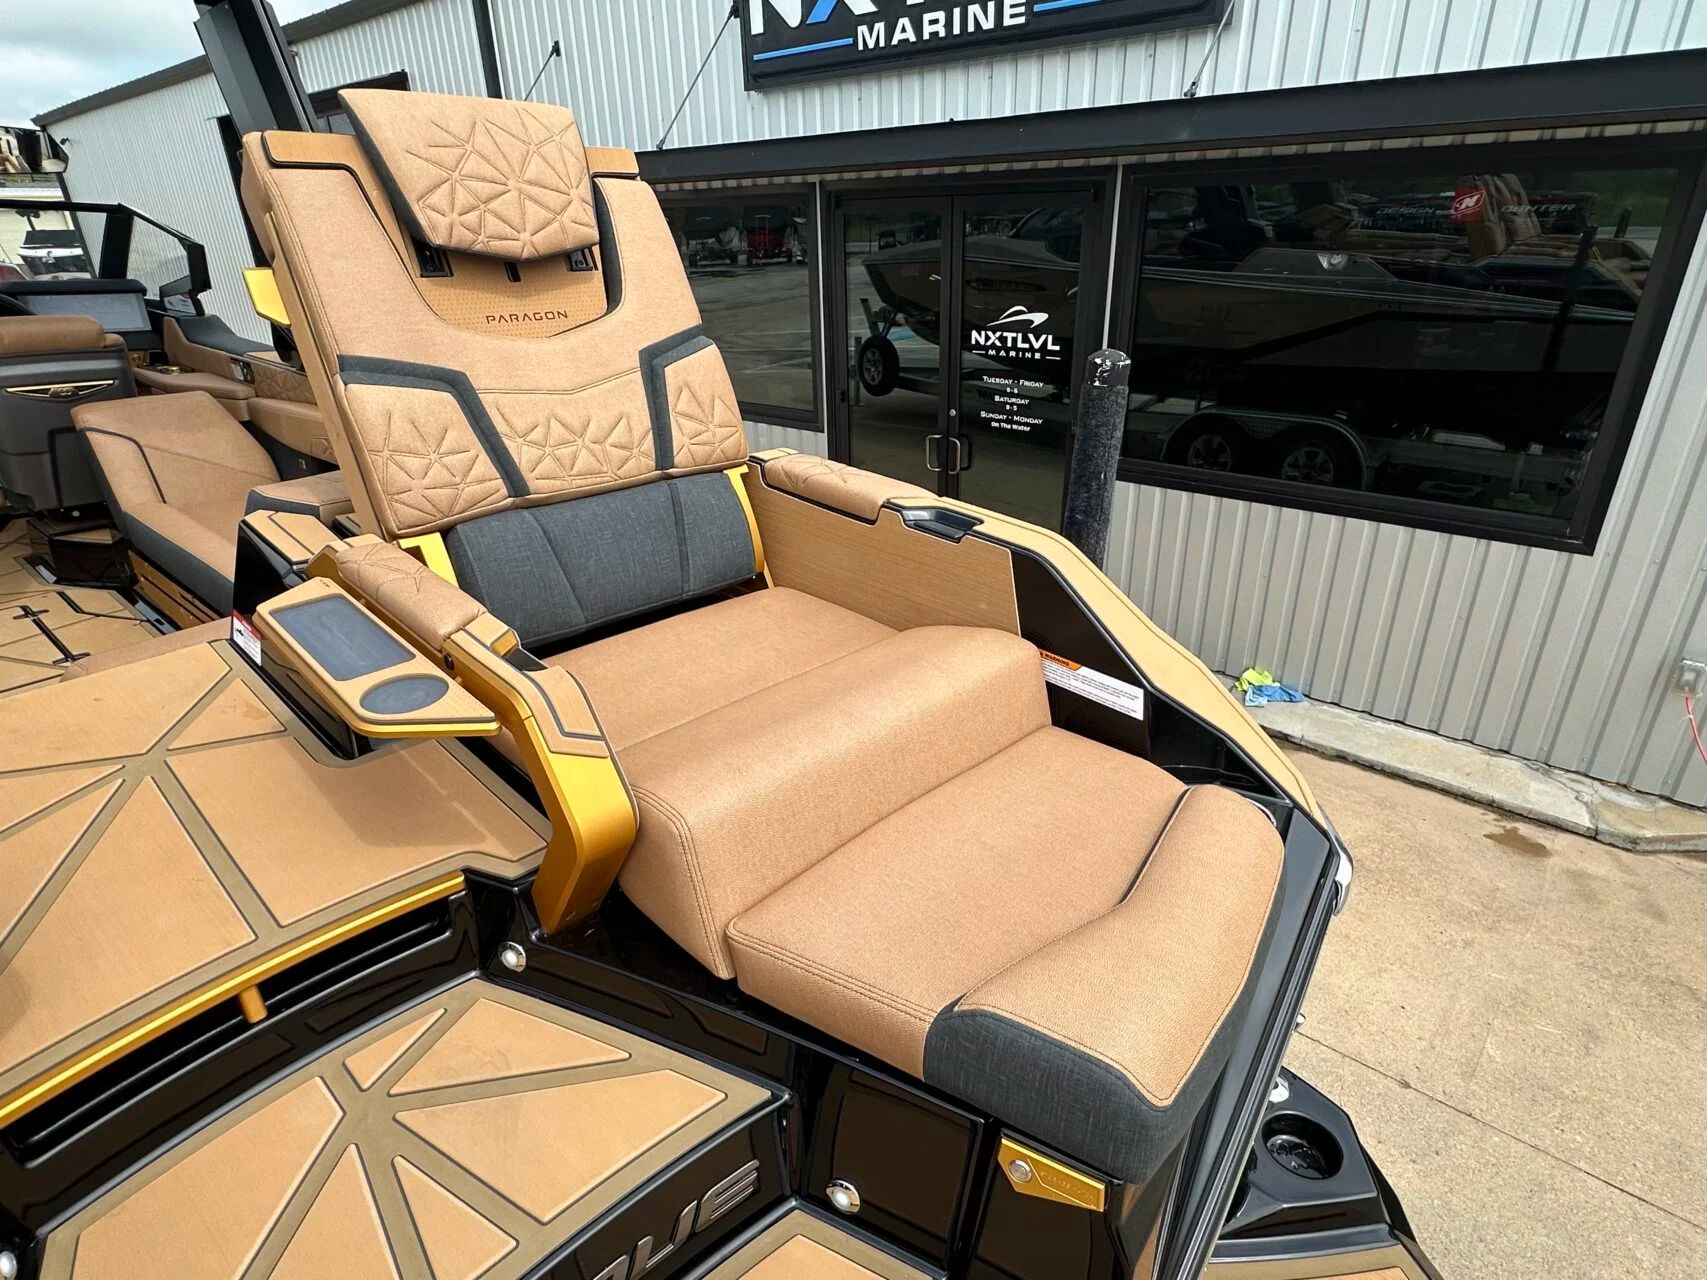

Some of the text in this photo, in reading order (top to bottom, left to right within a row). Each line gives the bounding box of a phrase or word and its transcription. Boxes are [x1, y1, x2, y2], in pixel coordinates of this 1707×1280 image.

[857, 0, 1026, 51] MARINE
[485, 310, 568, 324] PARAGON
[971, 329, 1060, 351] NXTLVL
[988, 349, 1041, 359] MARINE
